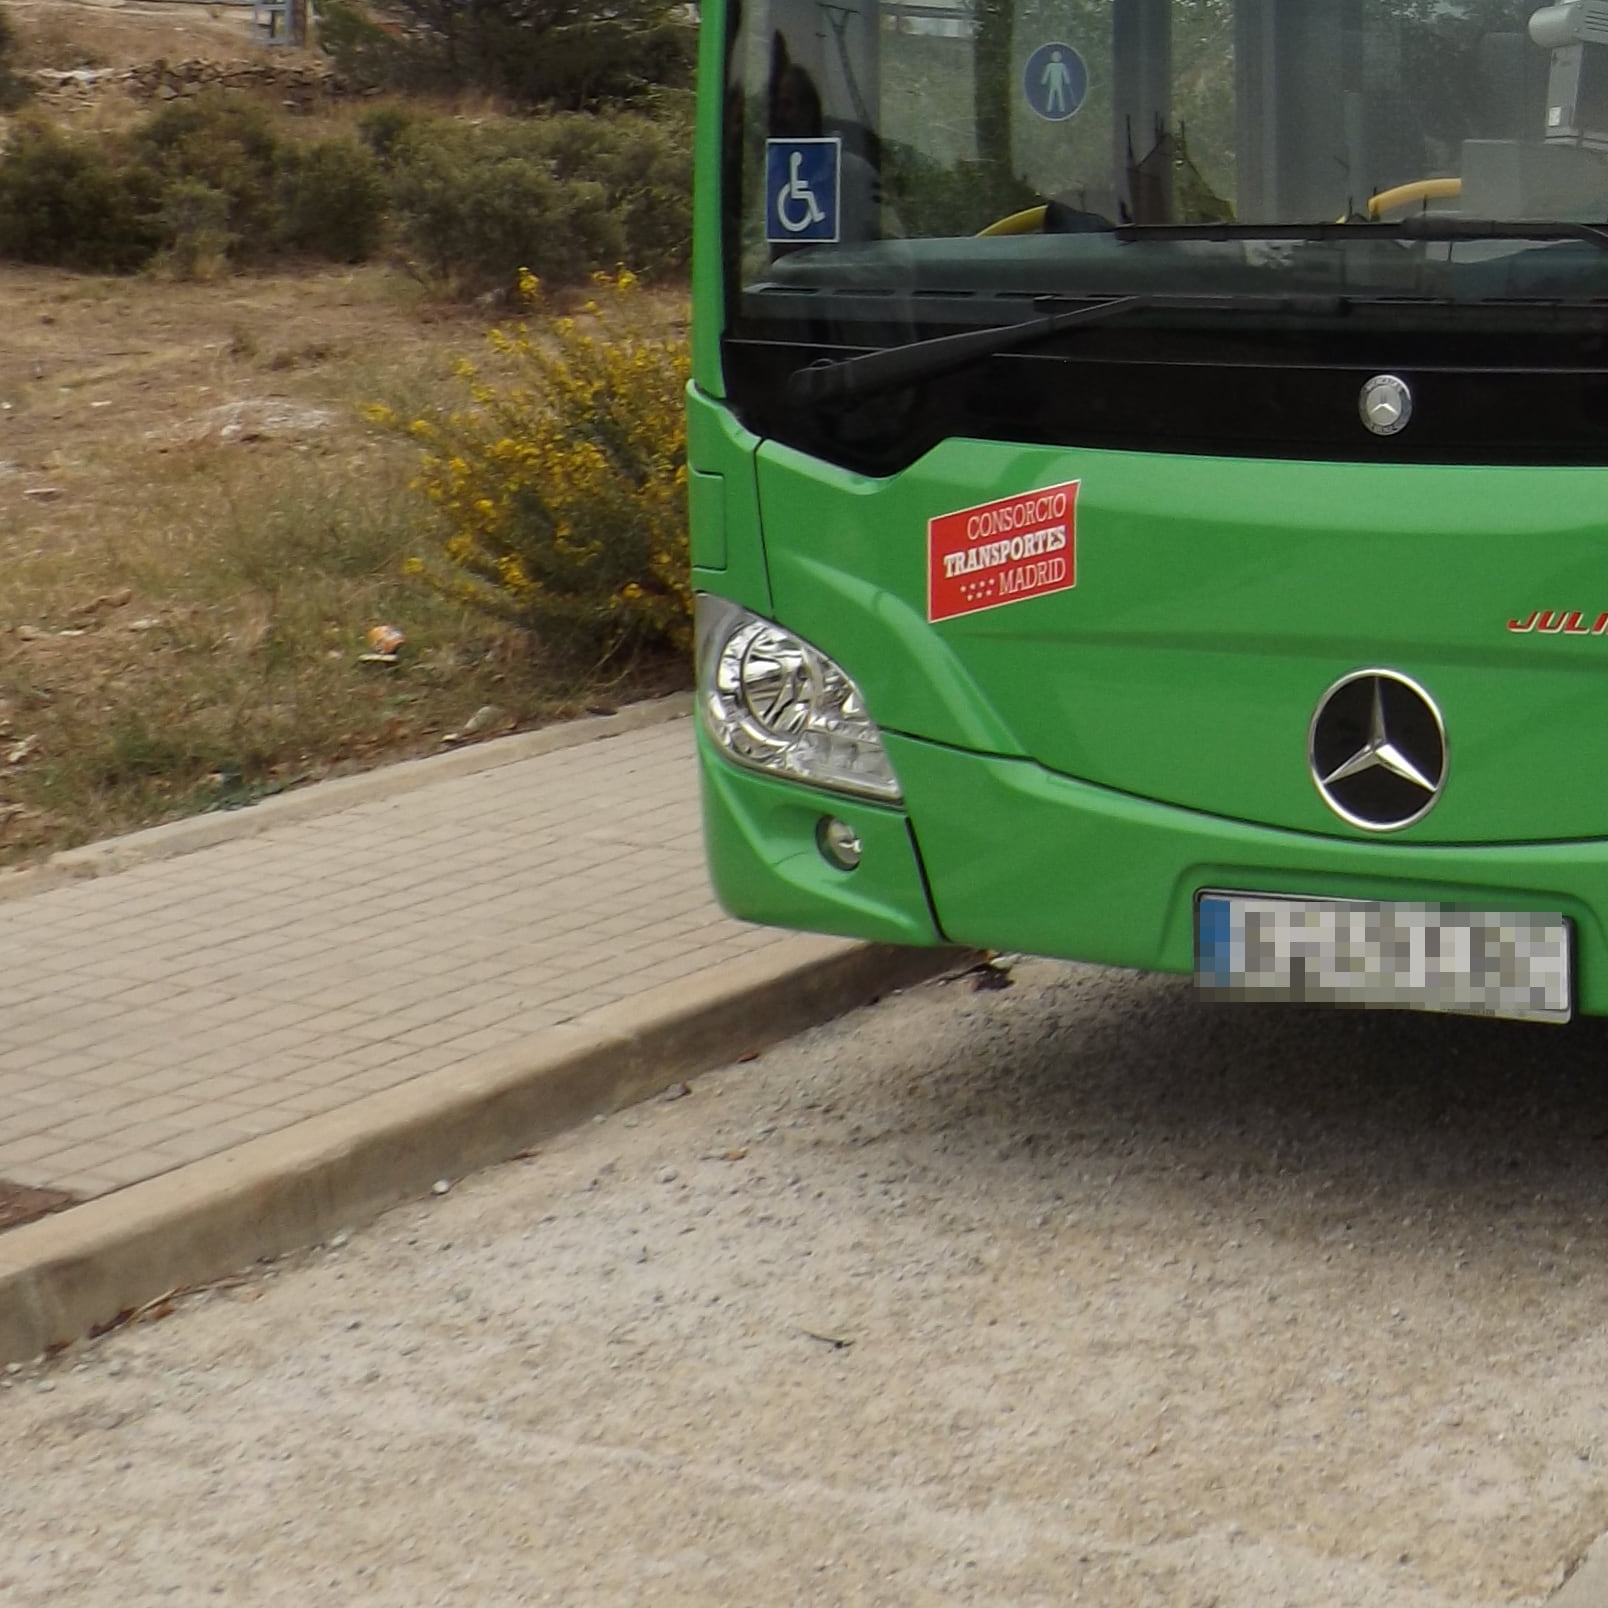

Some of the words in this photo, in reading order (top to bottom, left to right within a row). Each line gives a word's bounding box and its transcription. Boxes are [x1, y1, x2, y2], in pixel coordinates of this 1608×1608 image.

[966, 492, 1067, 540] CONSORCIO
[943, 524, 1067, 579] TRANSPORTES
[998, 557, 1067, 596] MADRID
